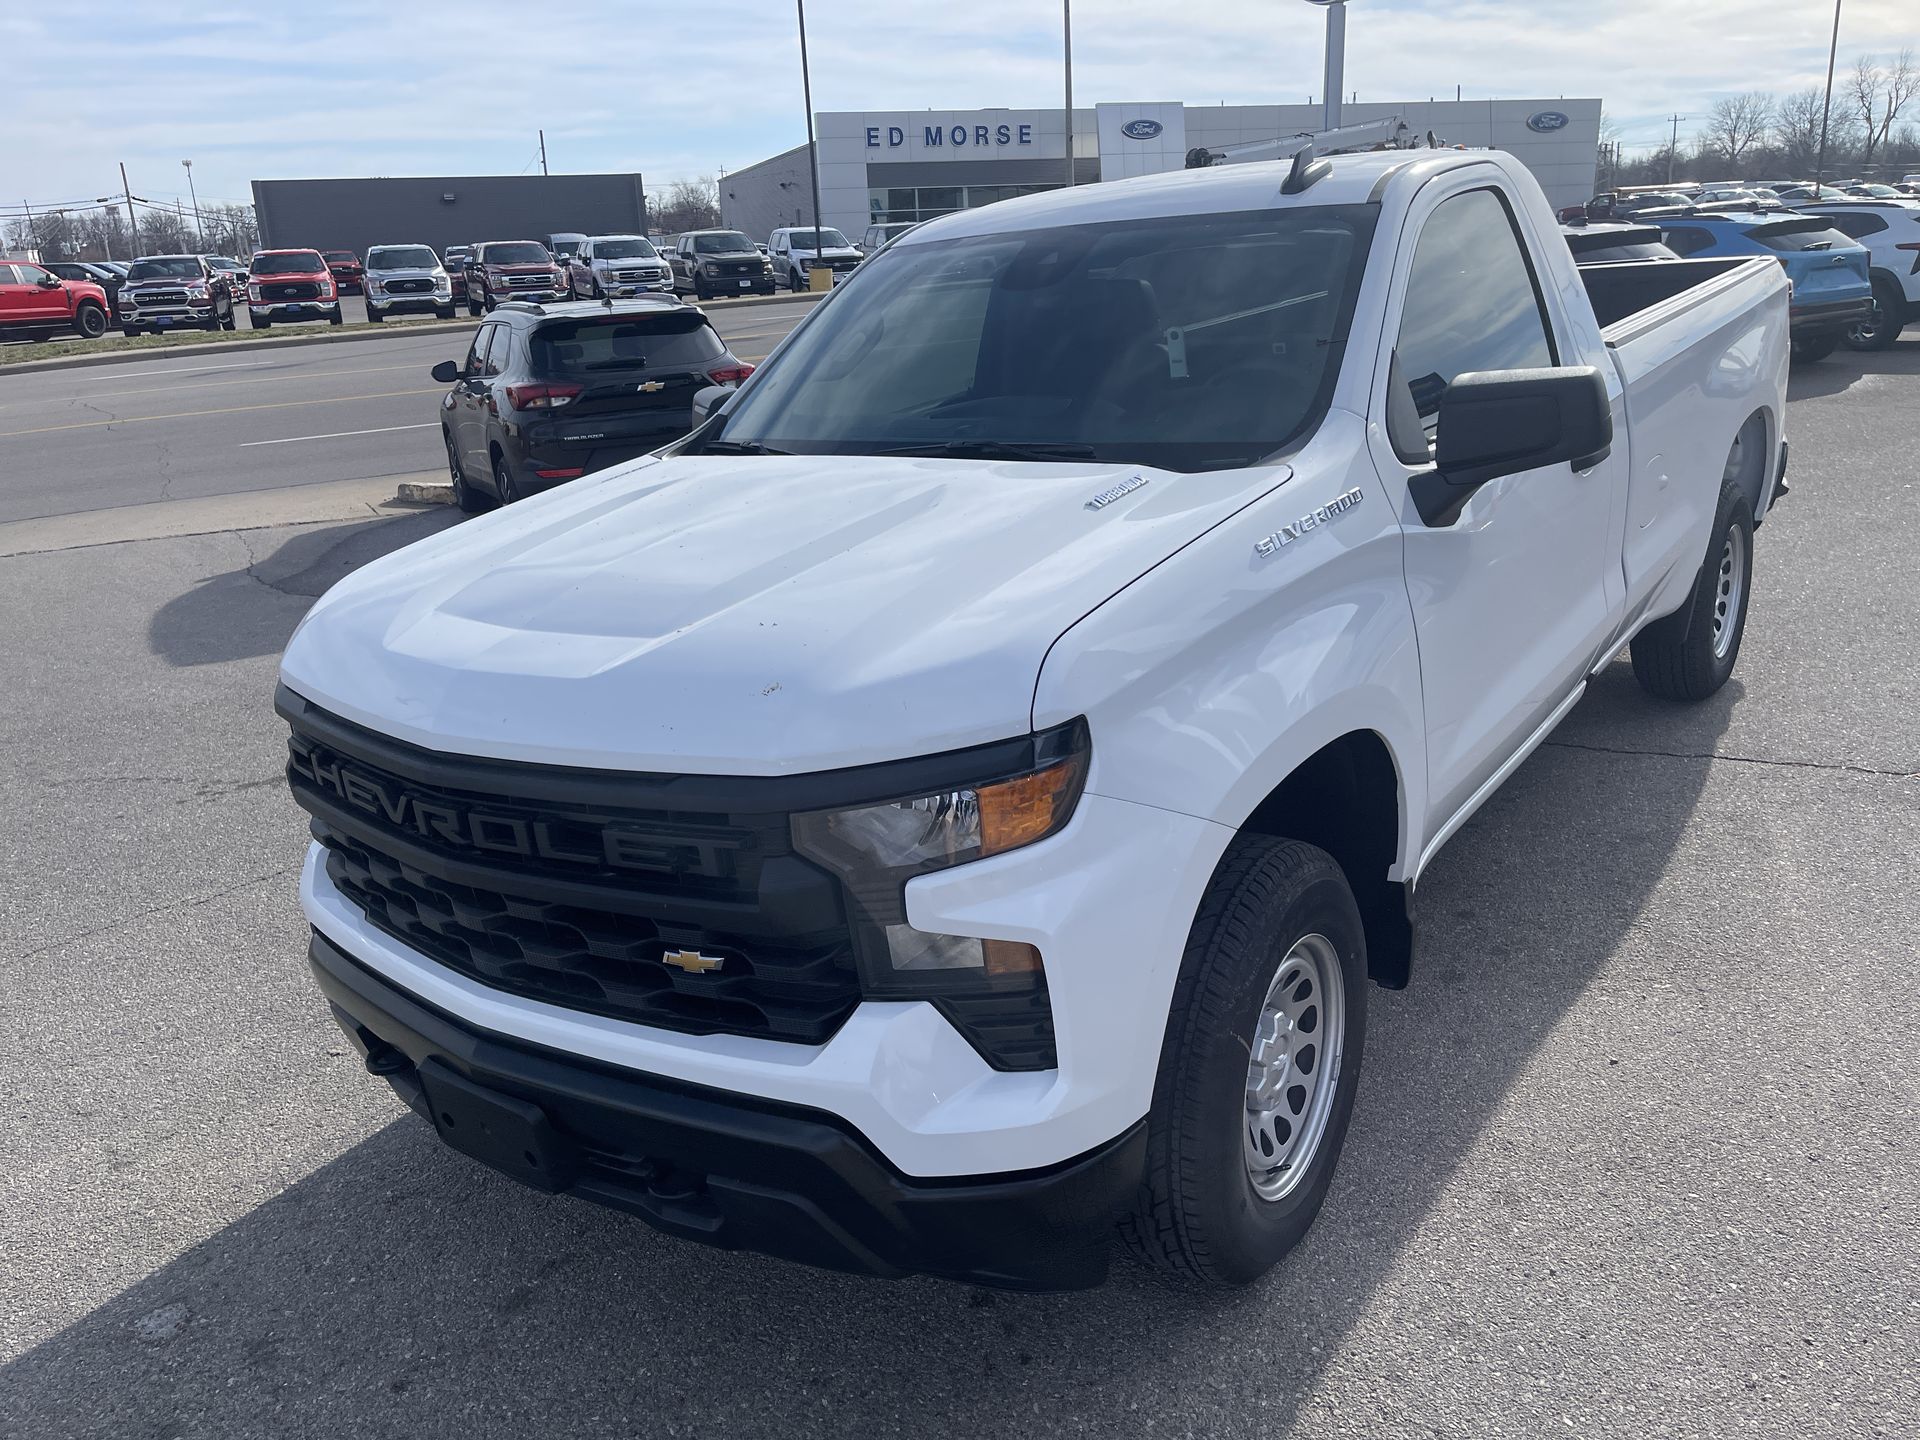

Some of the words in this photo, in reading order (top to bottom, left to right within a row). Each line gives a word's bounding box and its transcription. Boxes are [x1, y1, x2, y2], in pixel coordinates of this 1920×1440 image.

[866, 127, 904, 147] ED
[924, 125, 1032, 147] MORSE
[1255, 486, 1364, 558] SILVERADO
[289, 738, 744, 878] CHEVROLET
